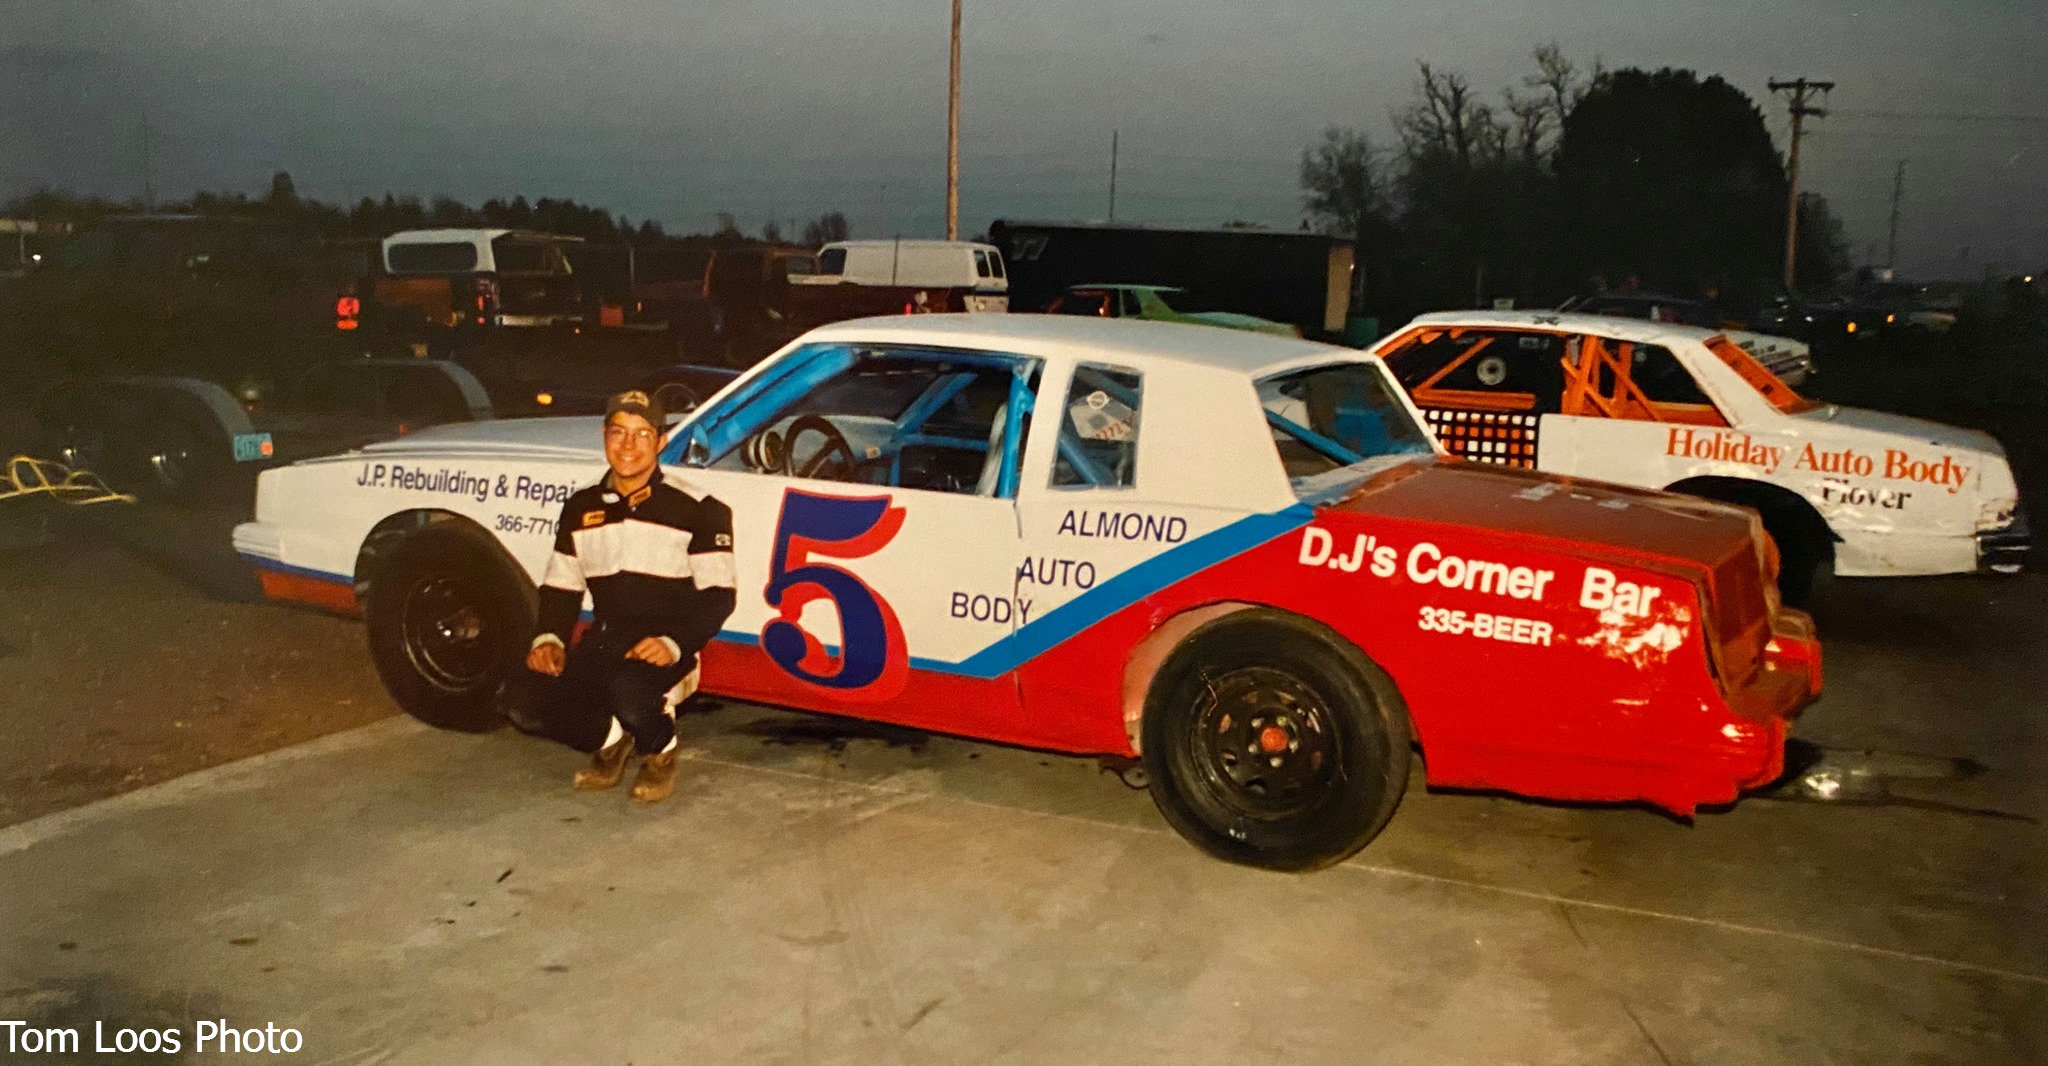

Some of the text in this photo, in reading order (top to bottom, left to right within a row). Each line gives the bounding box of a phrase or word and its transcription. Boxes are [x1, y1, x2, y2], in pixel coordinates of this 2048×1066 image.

[1665, 427, 1970, 494] Holiday Auto Body
[357, 463, 576, 507] J.P. Rebuilding & Repai
[1057, 509, 1188, 543] ALMOND
[1018, 556, 1096, 589] AUTO
[1299, 526, 1661, 618] D.J's Corner Bar
[760, 487, 909, 701] 5
[951, 591, 1033, 625] BODY
[1418, 606, 1553, 647] 335-BEER
